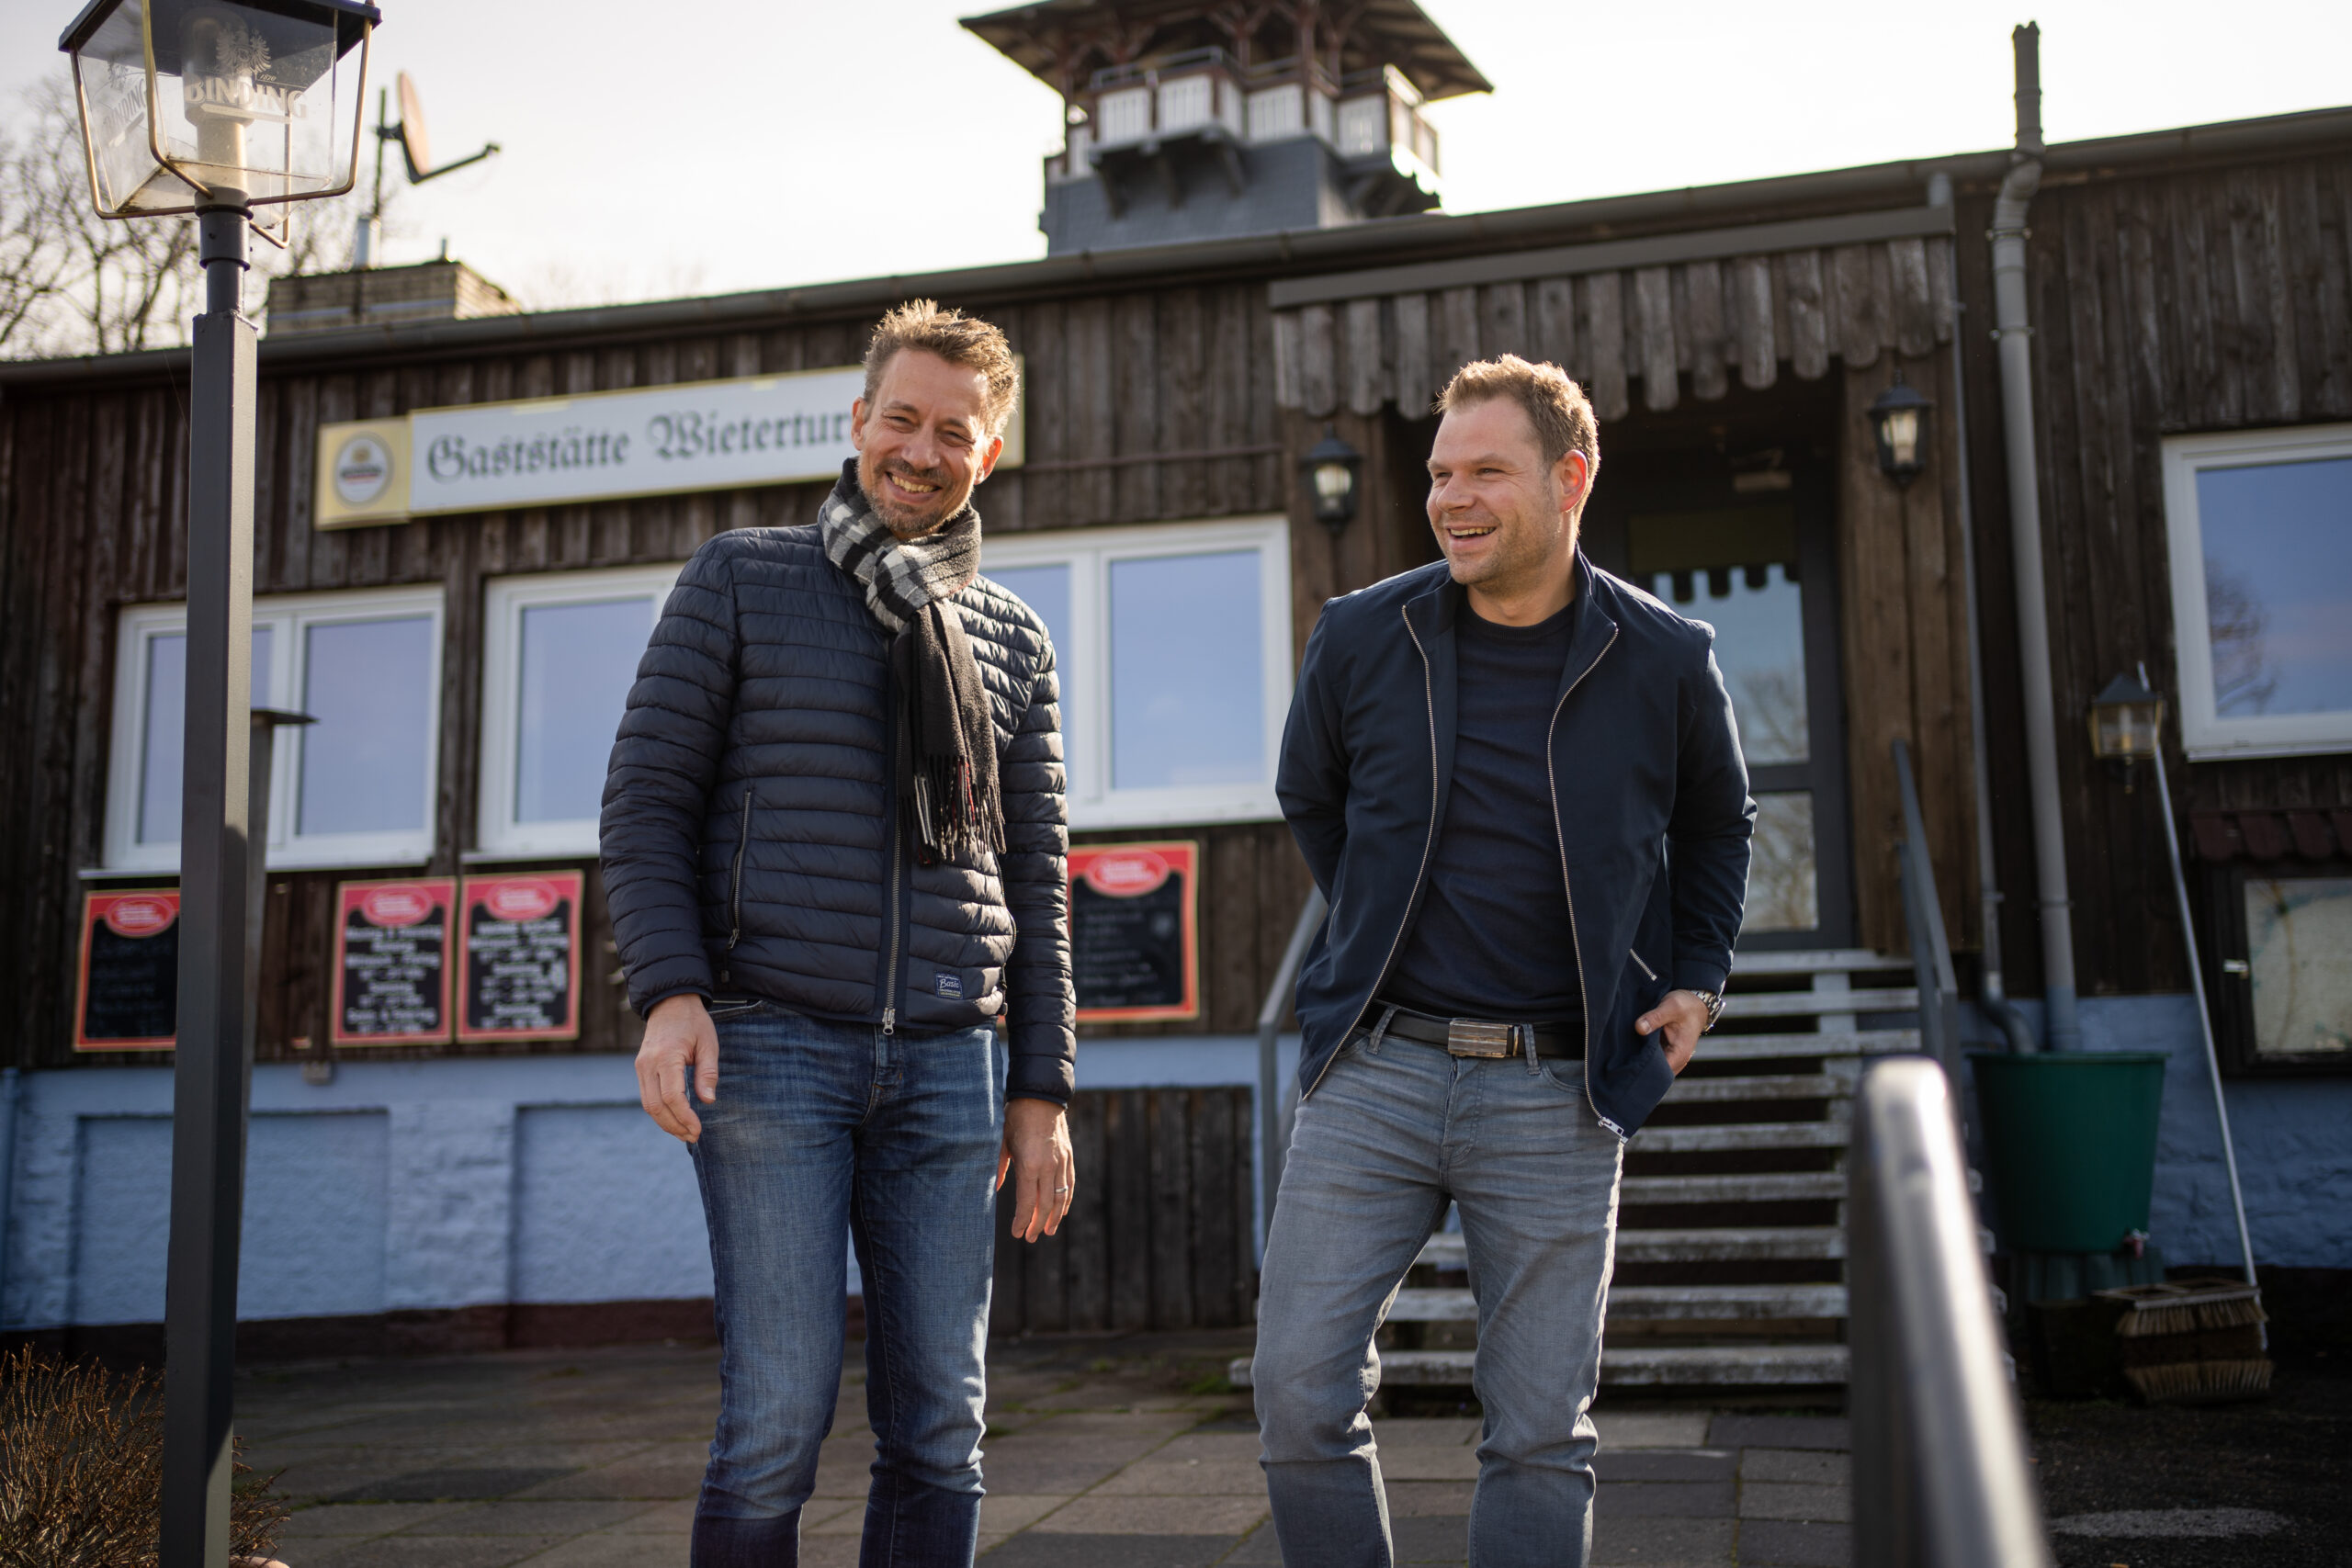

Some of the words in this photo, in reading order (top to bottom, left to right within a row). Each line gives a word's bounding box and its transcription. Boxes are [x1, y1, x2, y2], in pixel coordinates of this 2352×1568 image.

[184, 75, 309, 118] BINDING
[426, 426, 630, 484] Gaststätte
[647, 409, 852, 460] Wietertur
